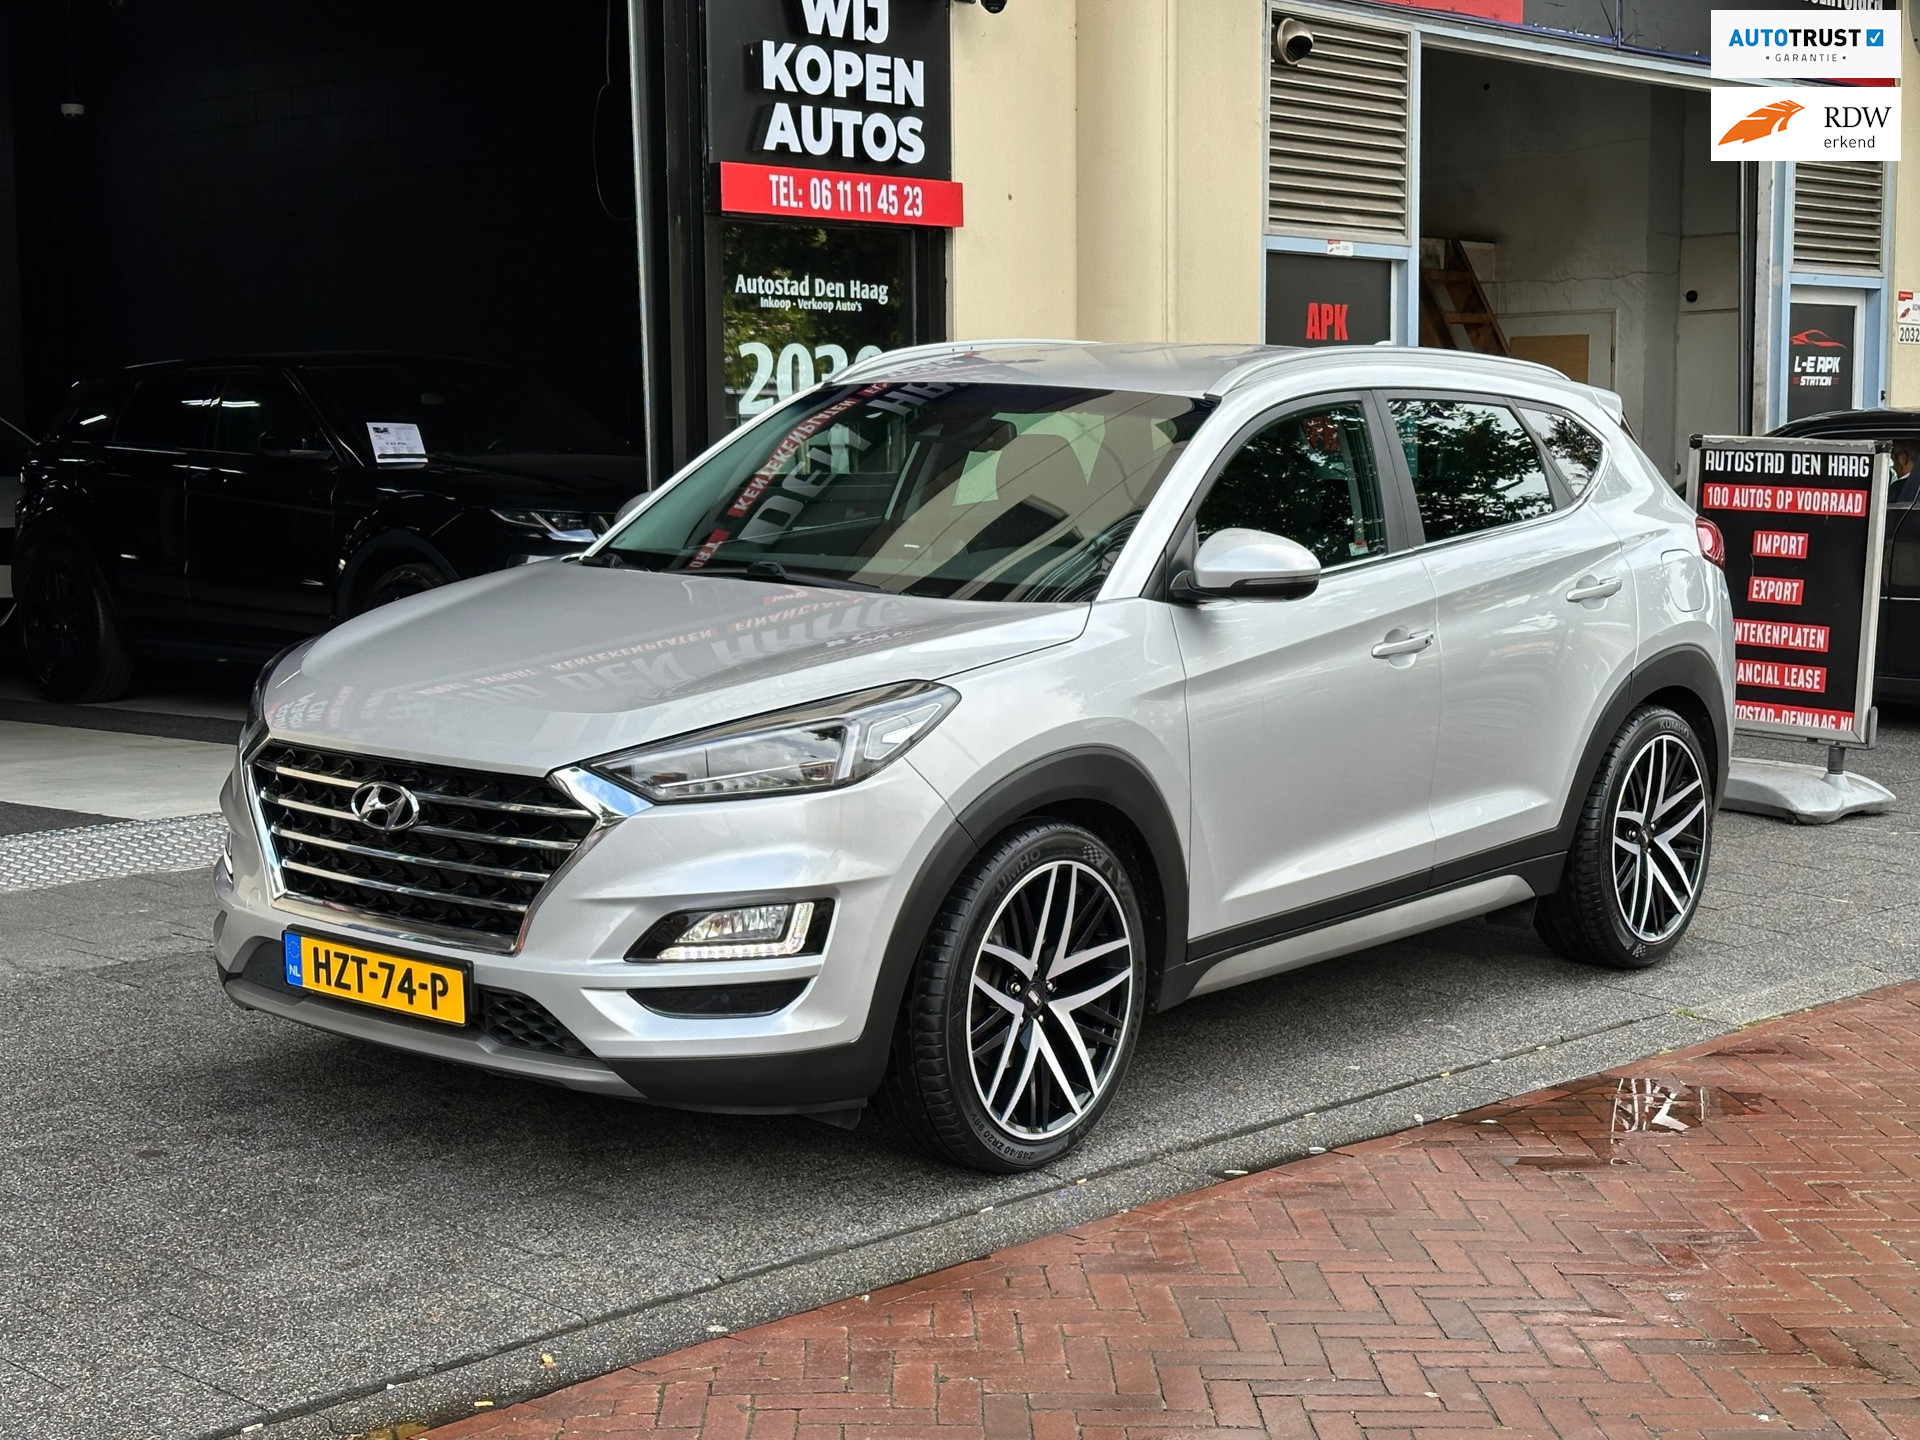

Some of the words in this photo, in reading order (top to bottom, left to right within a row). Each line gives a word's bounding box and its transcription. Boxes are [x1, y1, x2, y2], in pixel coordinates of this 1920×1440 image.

[802, 0, 890, 44] WIJ
[762, 39, 925, 108] KOPEN
[762, 102, 926, 165] AUTOS
[768, 173, 804, 209] TEL:
[809, 177, 833, 212] 06
[836, 180, 853, 213] 11
[856, 181, 873, 214] 11
[877, 183, 900, 216] 45
[903, 185, 924, 218] 23
[734, 273, 810, 298] Autostad
[814, 278, 845, 299] Den
[850, 280, 889, 305] Haag
[760, 296, 791, 312] Inkoop
[797, 298, 834, 314] Verkoop
[835, 300, 863, 312] Auto's
[1305, 302, 1349, 341] APK
[1899, 327, 1920, 343] 2032
[738, 342, 884, 415] 203
[1799, 375, 1833, 387] STATION
[1704, 450, 1785, 474] AUTOSTAD
[1791, 453, 1822, 476] DEN
[1828, 455, 1870, 478] HAAG
[1707, 486, 1730, 507] 100
[1732, 487, 1773, 509] AUTOS
[1776, 489, 1794, 510] OP
[1796, 490, 1864, 514] VOORRAAD
[1756, 533, 1805, 557] IMPORT
[1752, 579, 1800, 602] EXPORT
[1734, 621, 1826, 650] NTEKENPLATEN
[1736, 662, 1780, 686] ANCIAL
[1783, 666, 1822, 690] LEASE
[1659, 719, 1690, 739] KUMHO
[288, 963, 302, 978] NL
[312, 946, 450, 1011] HZT-74-P
[1003, 1144, 1036, 1160] 245/40
